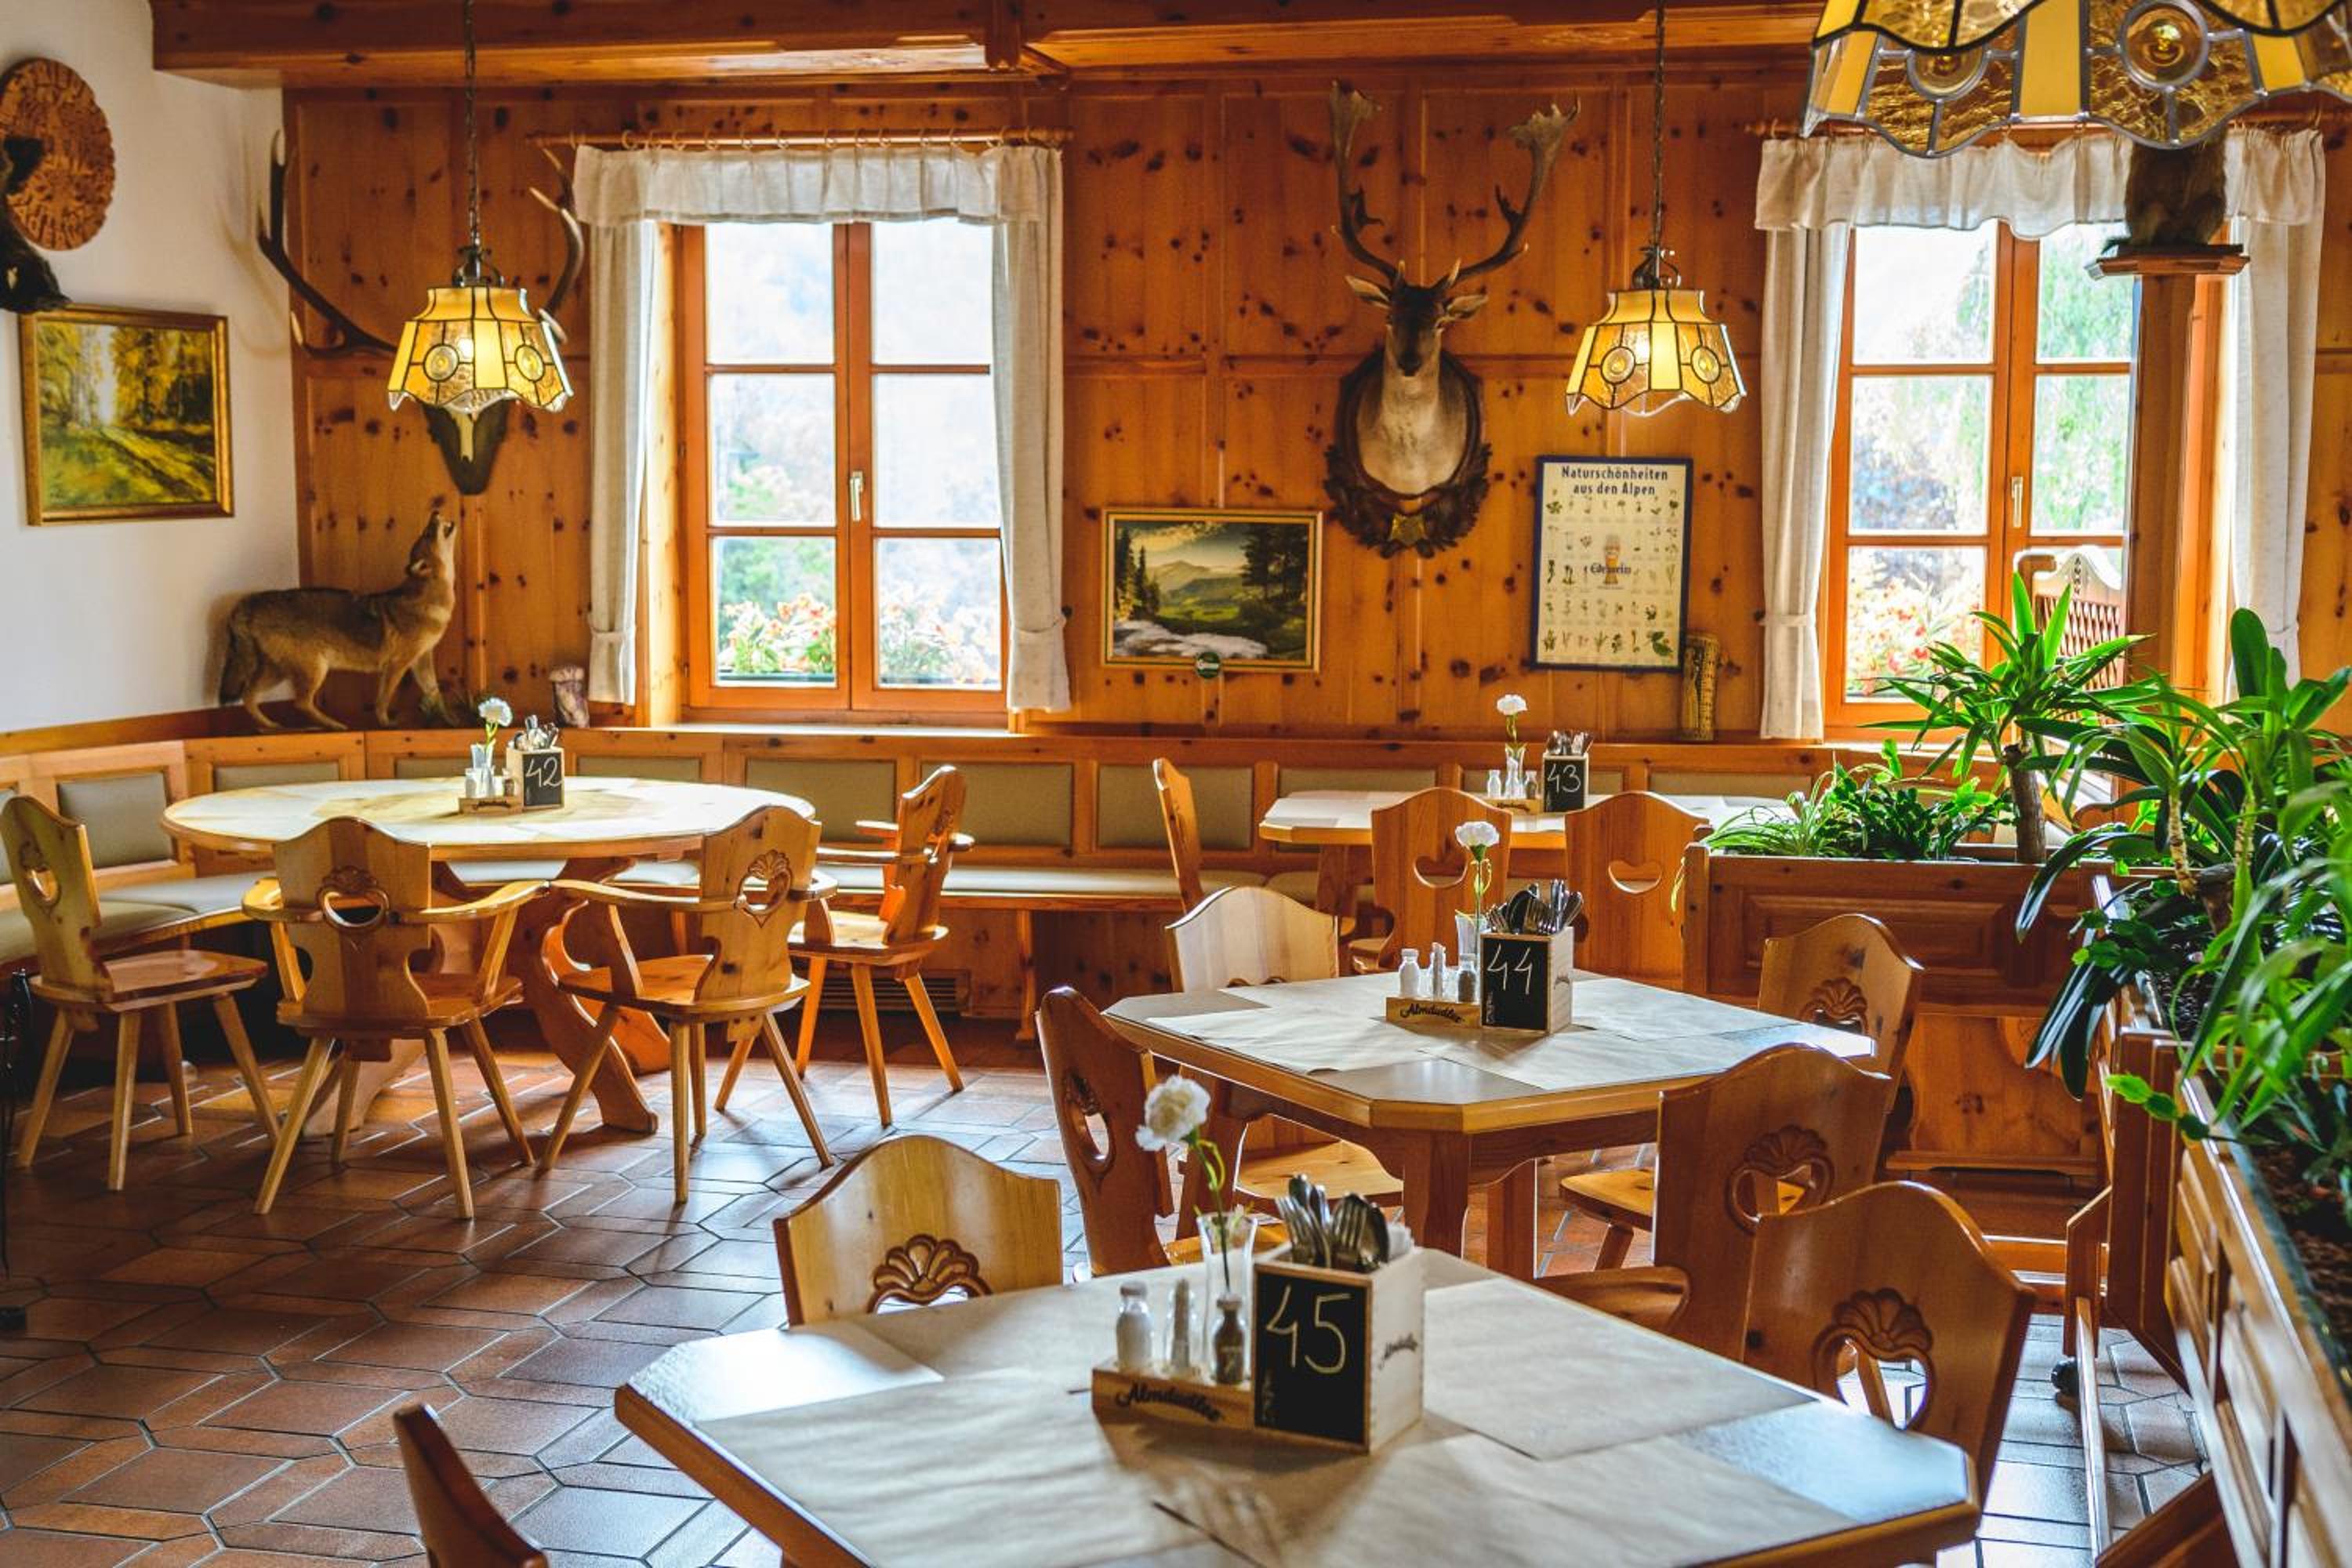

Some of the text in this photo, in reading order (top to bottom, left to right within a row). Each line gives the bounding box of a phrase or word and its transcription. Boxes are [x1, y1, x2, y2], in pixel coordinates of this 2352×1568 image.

[1562, 466, 1668, 480] Naturschönheiten
[1573, 481, 1655, 497] aus den Alpen
[526, 757, 564, 787] 42
[1548, 764, 1581, 793] 43
[1487, 944, 1532, 995] 44
[1266, 1285, 1353, 1374] 45
